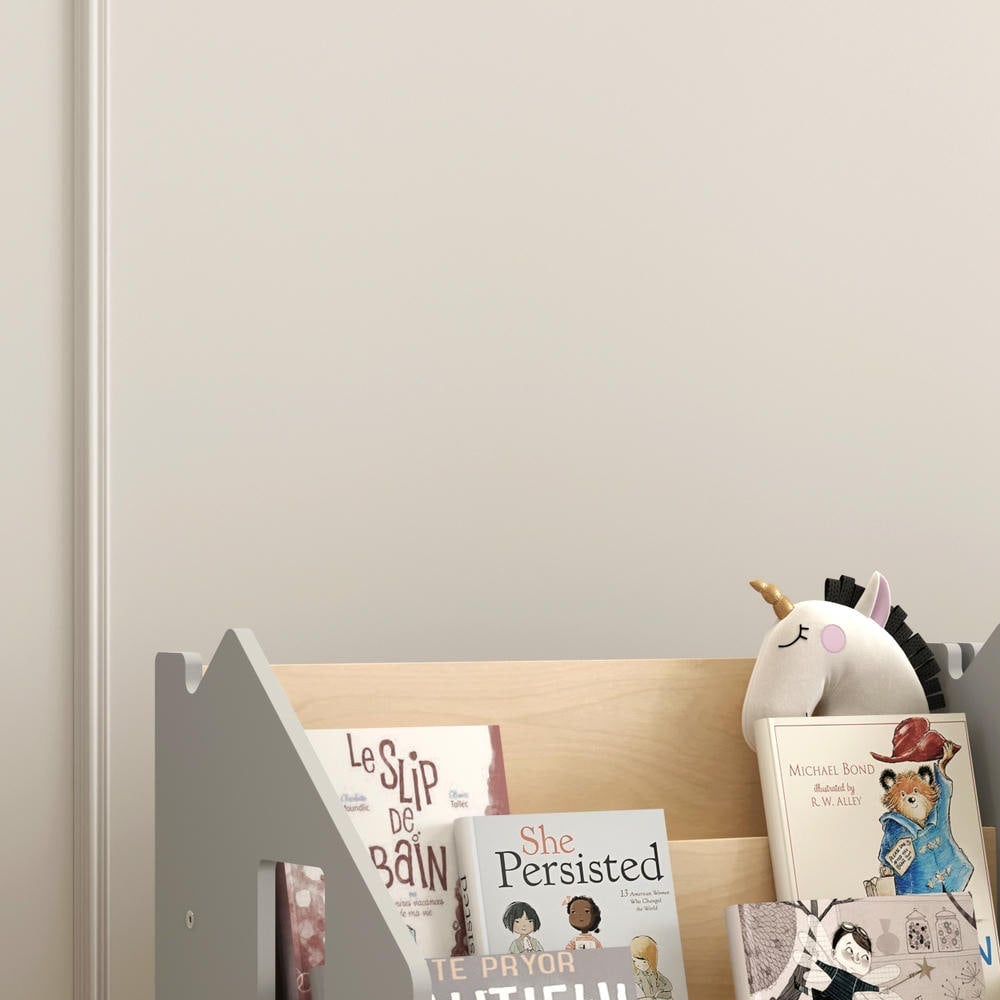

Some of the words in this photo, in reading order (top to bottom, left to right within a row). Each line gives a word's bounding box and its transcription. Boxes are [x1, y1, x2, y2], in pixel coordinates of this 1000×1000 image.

[346, 733, 376, 773] Le
[813, 783, 846, 793] illustrated
[846, 782, 855, 795] by
[836, 796, 862, 807] ALLEY
[520, 824, 575, 855] She
[495, 842, 664, 888] Persisted
[620, 889, 629, 897] 13
[482, 951, 576, 978] PRYOR
